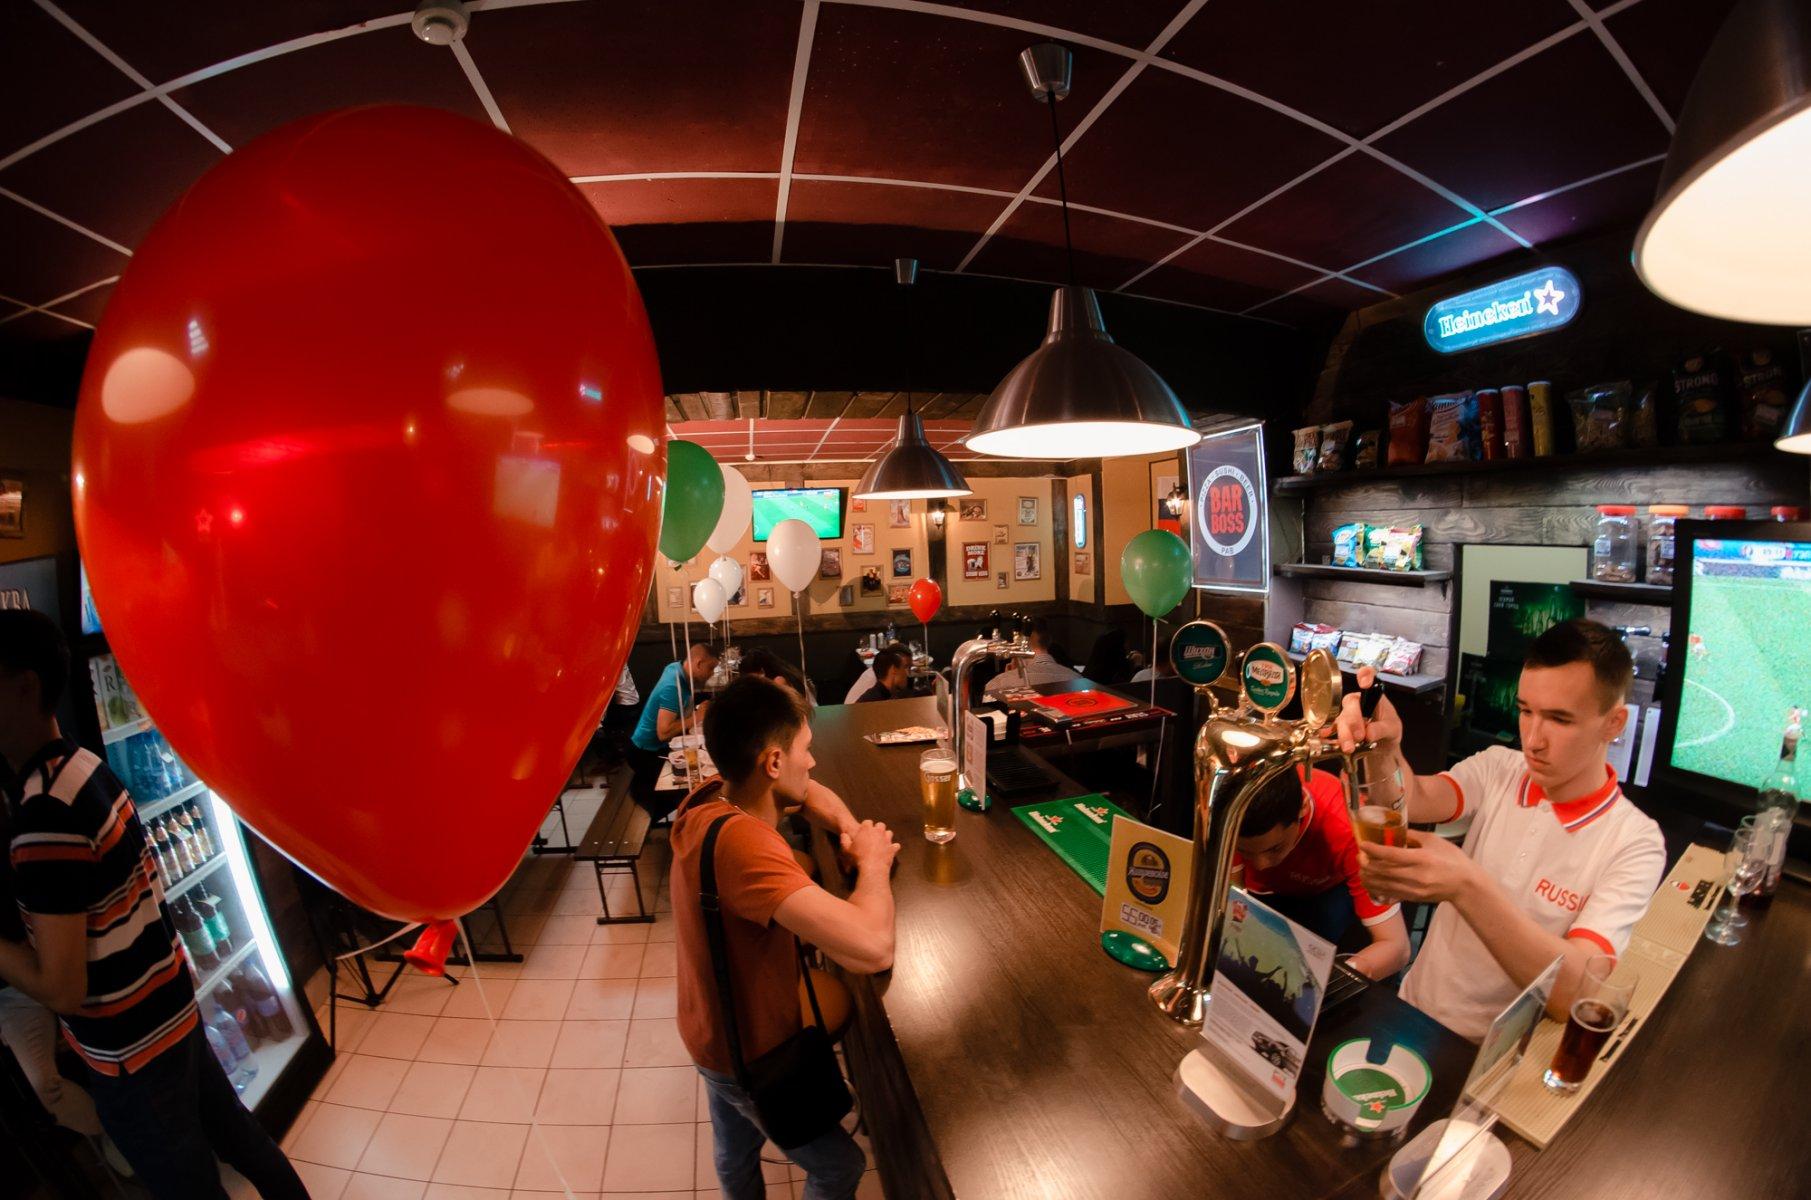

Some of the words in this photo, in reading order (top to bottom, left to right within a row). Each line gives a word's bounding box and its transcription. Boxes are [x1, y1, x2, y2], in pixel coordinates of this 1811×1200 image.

[1438, 291, 1534, 338] Heineken
[1210, 484, 1243, 512] BAR
[1211, 512, 1245, 535] BOSS
